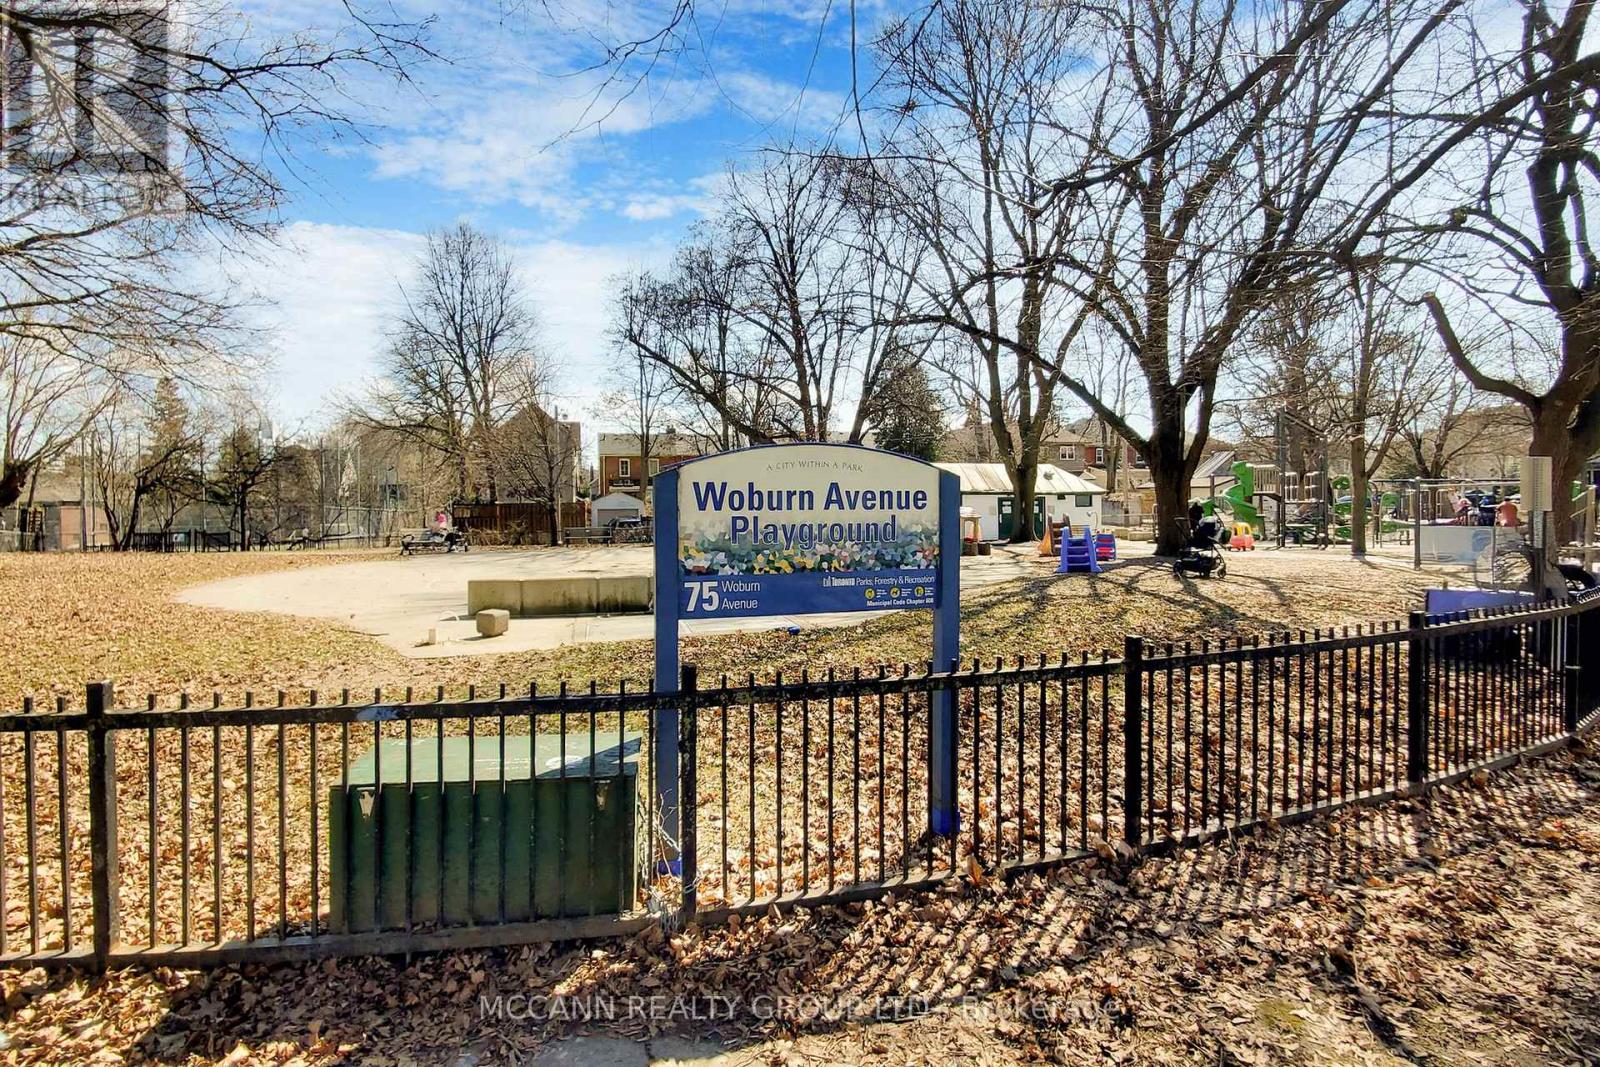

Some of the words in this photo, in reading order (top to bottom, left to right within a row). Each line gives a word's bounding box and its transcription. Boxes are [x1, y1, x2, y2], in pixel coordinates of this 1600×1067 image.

[766, 463, 774, 472] A
[776, 461, 796, 470] CITY
[798, 460, 830, 468] WITHIN
[832, 461, 838, 469] A
[841, 462, 863, 473] PARK
[692, 481, 815, 511] Woburn
[823, 481, 928, 511] Avenue
[730, 514, 897, 551] Playground
[721, 580, 761, 593] Woburn
[874, 576, 897, 586] Forestry
[898, 576, 904, 584] &
[904, 574, 935, 584] Recreation
[683, 581, 720, 612] 75
[906, 598, 925, 606] Chapter
[721, 597, 759, 610] Avenue
